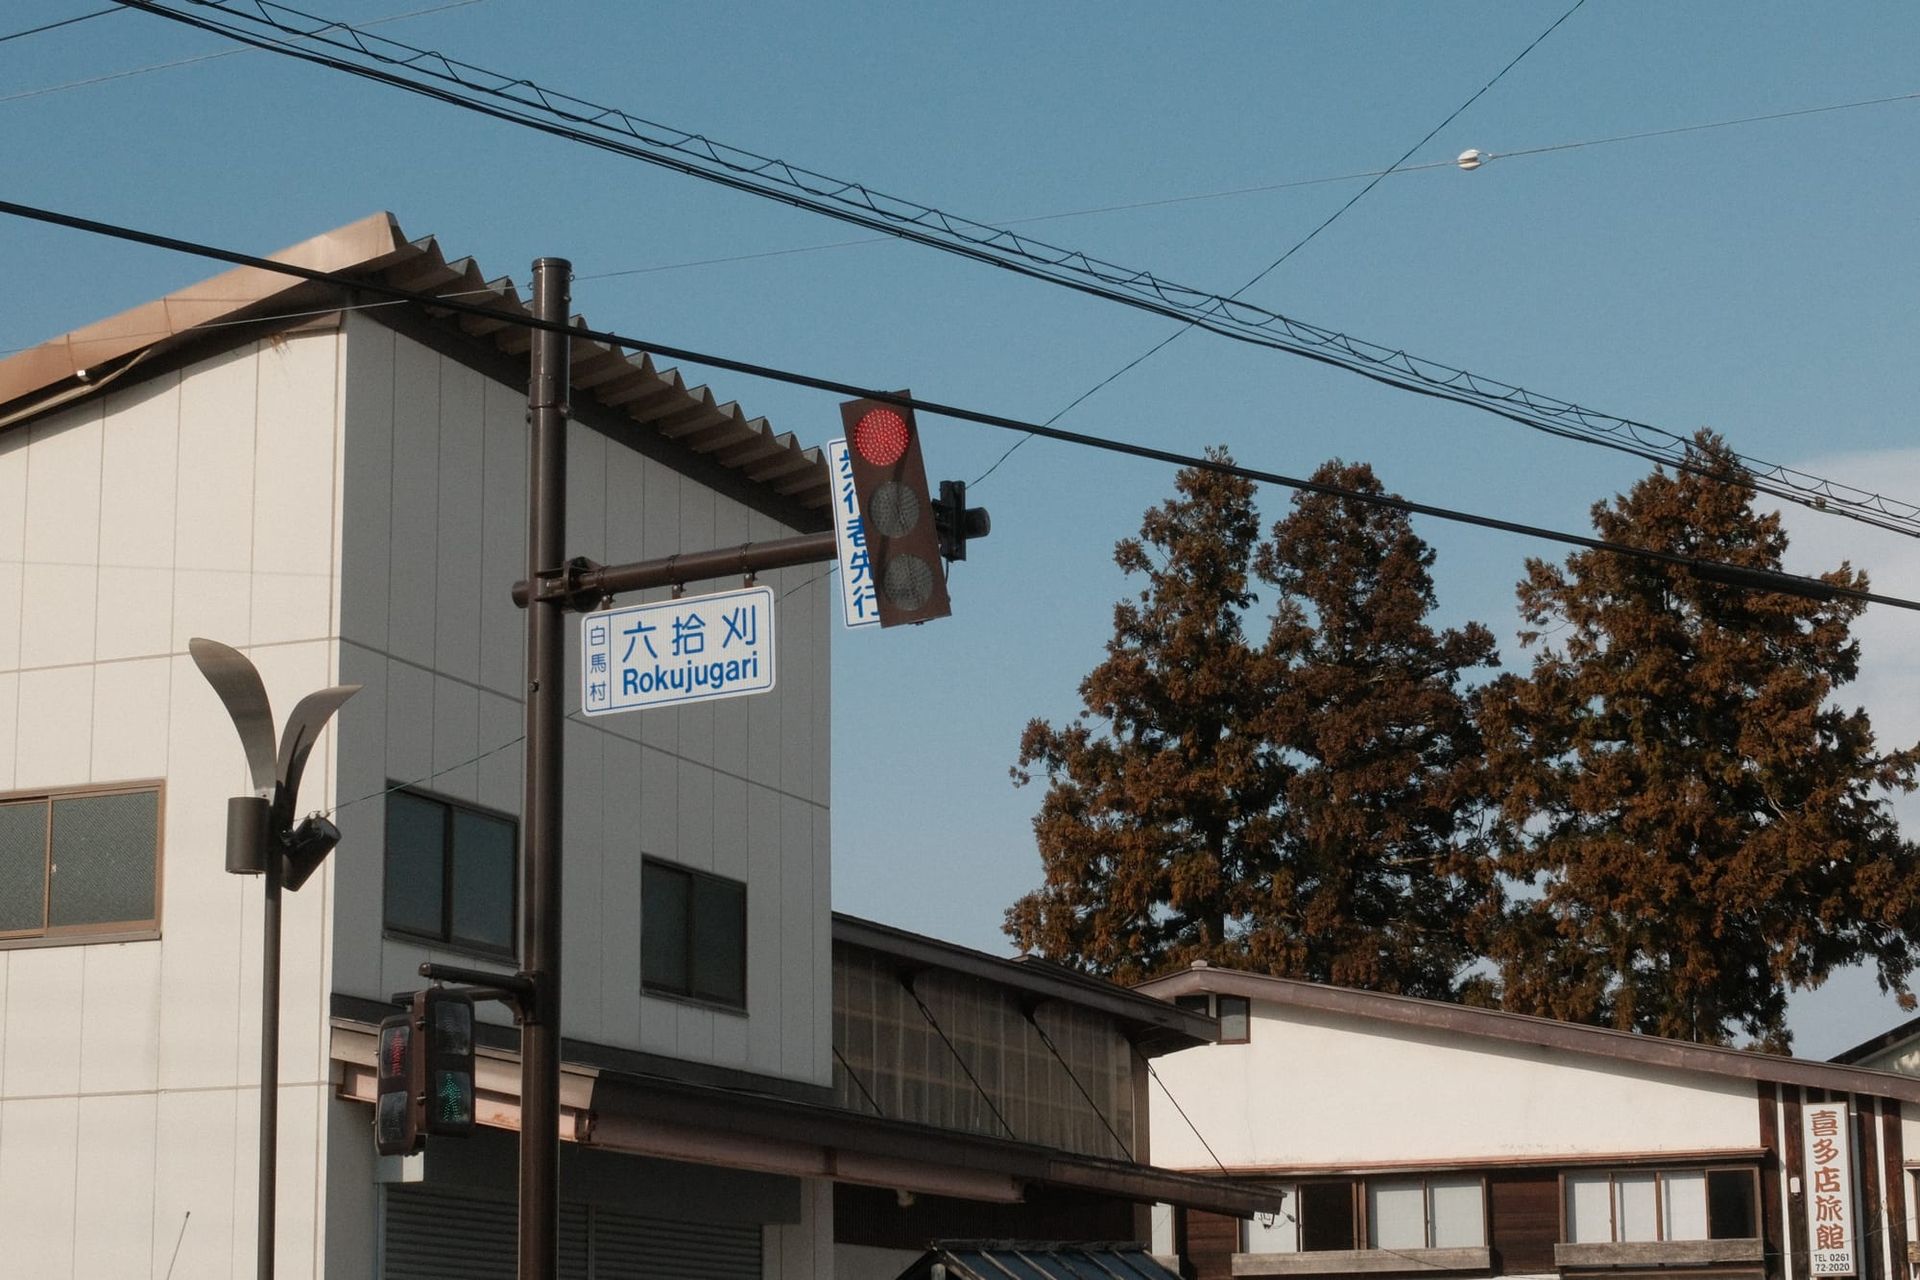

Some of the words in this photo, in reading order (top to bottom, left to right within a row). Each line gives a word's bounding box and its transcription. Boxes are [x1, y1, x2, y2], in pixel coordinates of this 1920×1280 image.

[622, 604, 757, 663] 六拾刈
[590, 625, 607, 702] 白馬村
[622, 651, 758, 696] Rokujugari
[1810, 1110, 1844, 1250] 喜多店旅館
[1814, 1254, 1827, 1262] TEL
[1829, 1253, 1850, 1262] 0261
[1815, 1262, 1850, 1272] 72-2020
